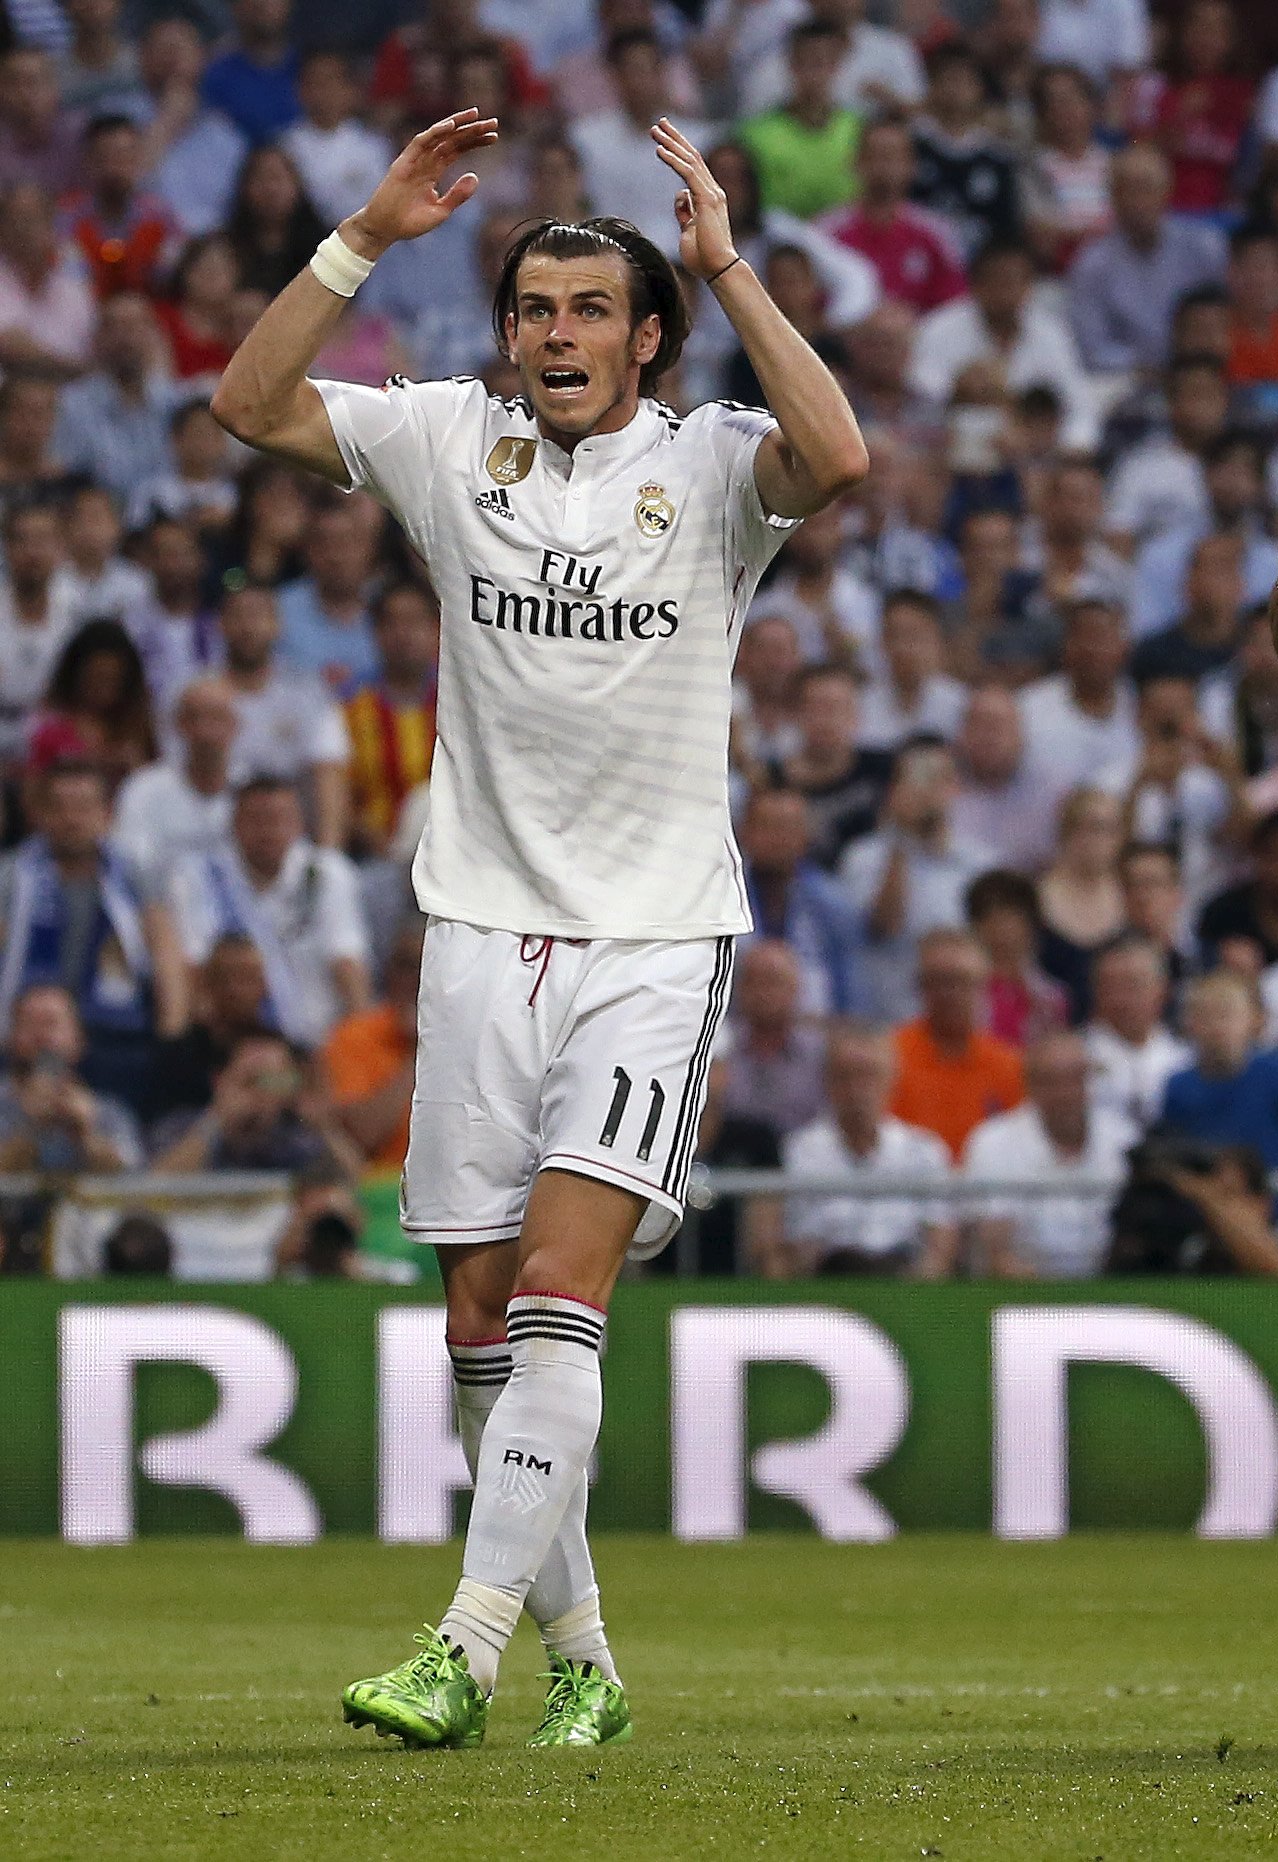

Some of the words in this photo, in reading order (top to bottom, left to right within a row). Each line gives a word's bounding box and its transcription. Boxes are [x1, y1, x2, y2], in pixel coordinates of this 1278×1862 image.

[496, 466, 520, 479] FIFA
[475, 496, 517, 522] adidas
[540, 549, 602, 595] Fly
[469, 574, 679, 641] Emirates
[598, 1065, 666, 1162] 11
[503, 1448, 553, 1476] RM
